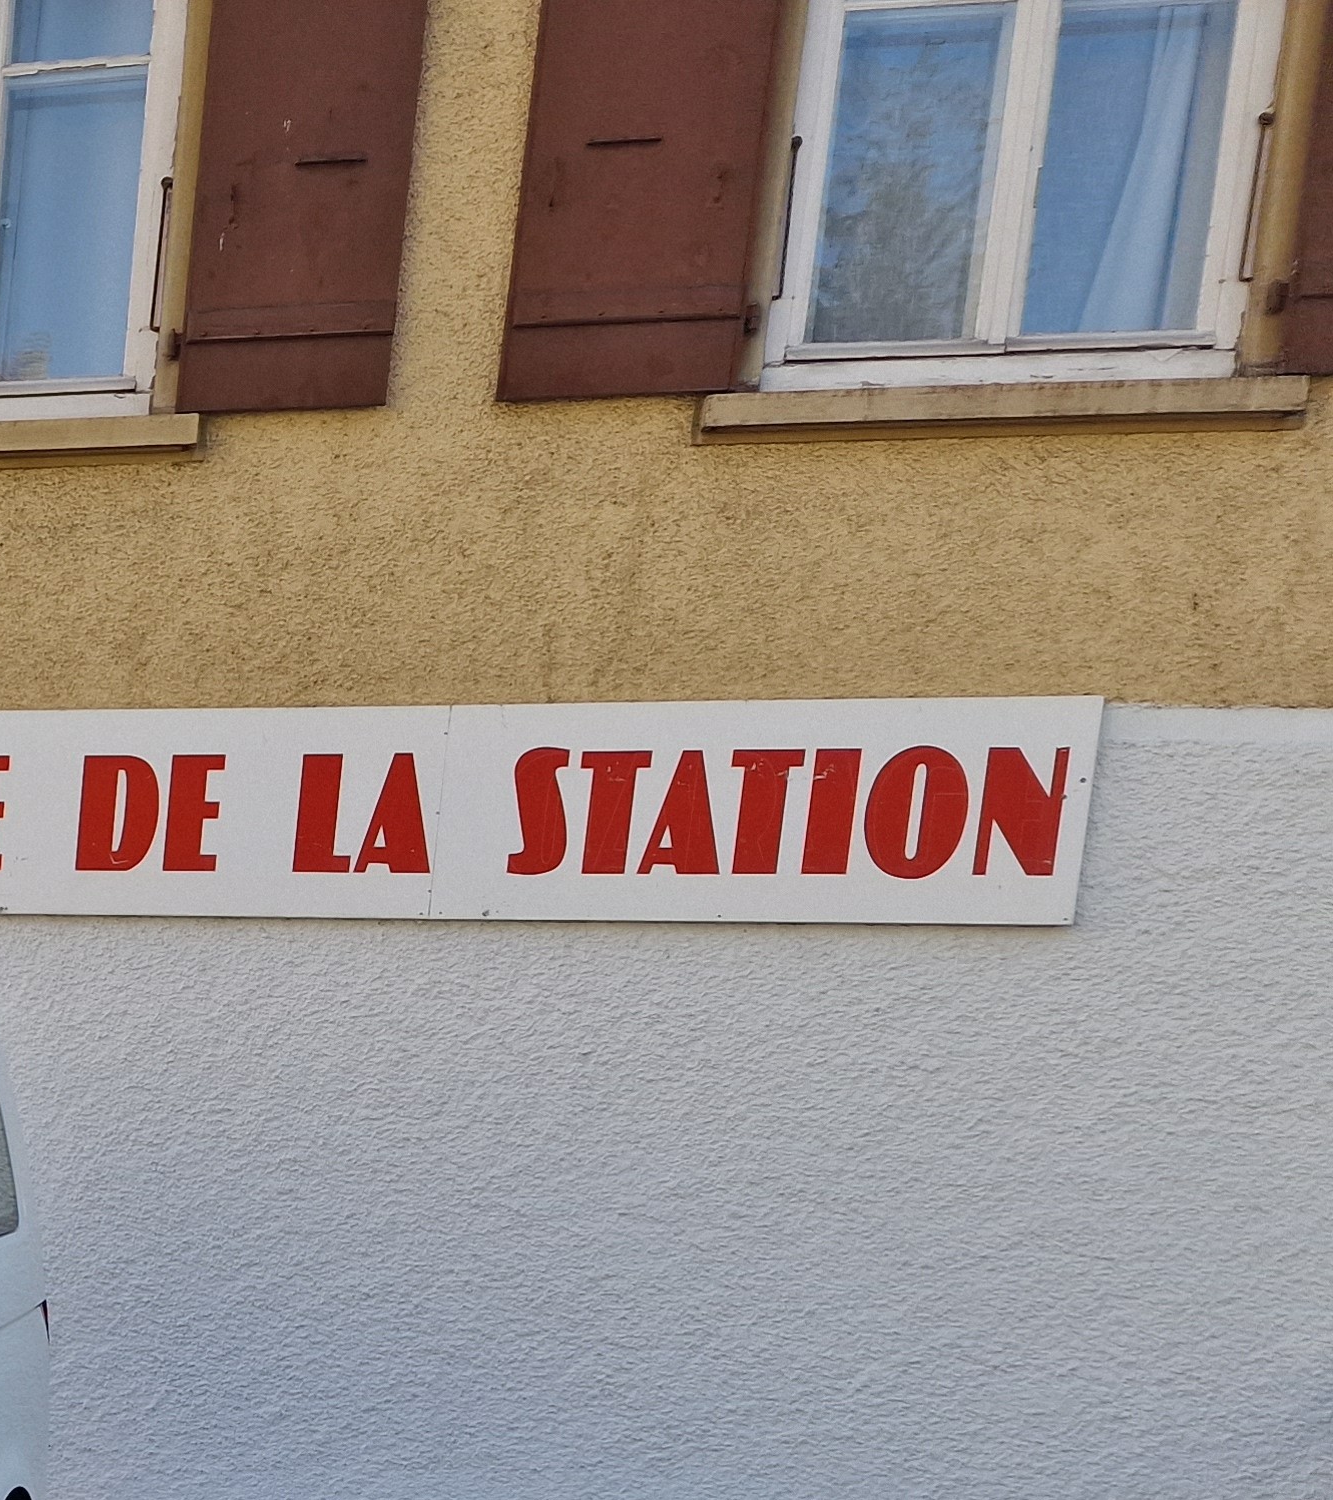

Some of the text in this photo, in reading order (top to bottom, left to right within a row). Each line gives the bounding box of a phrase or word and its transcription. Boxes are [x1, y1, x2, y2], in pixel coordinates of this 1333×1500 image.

[74, 753, 227, 873] DE
[291, 751, 431, 875] LA
[505, 744, 1072, 880] STATION
